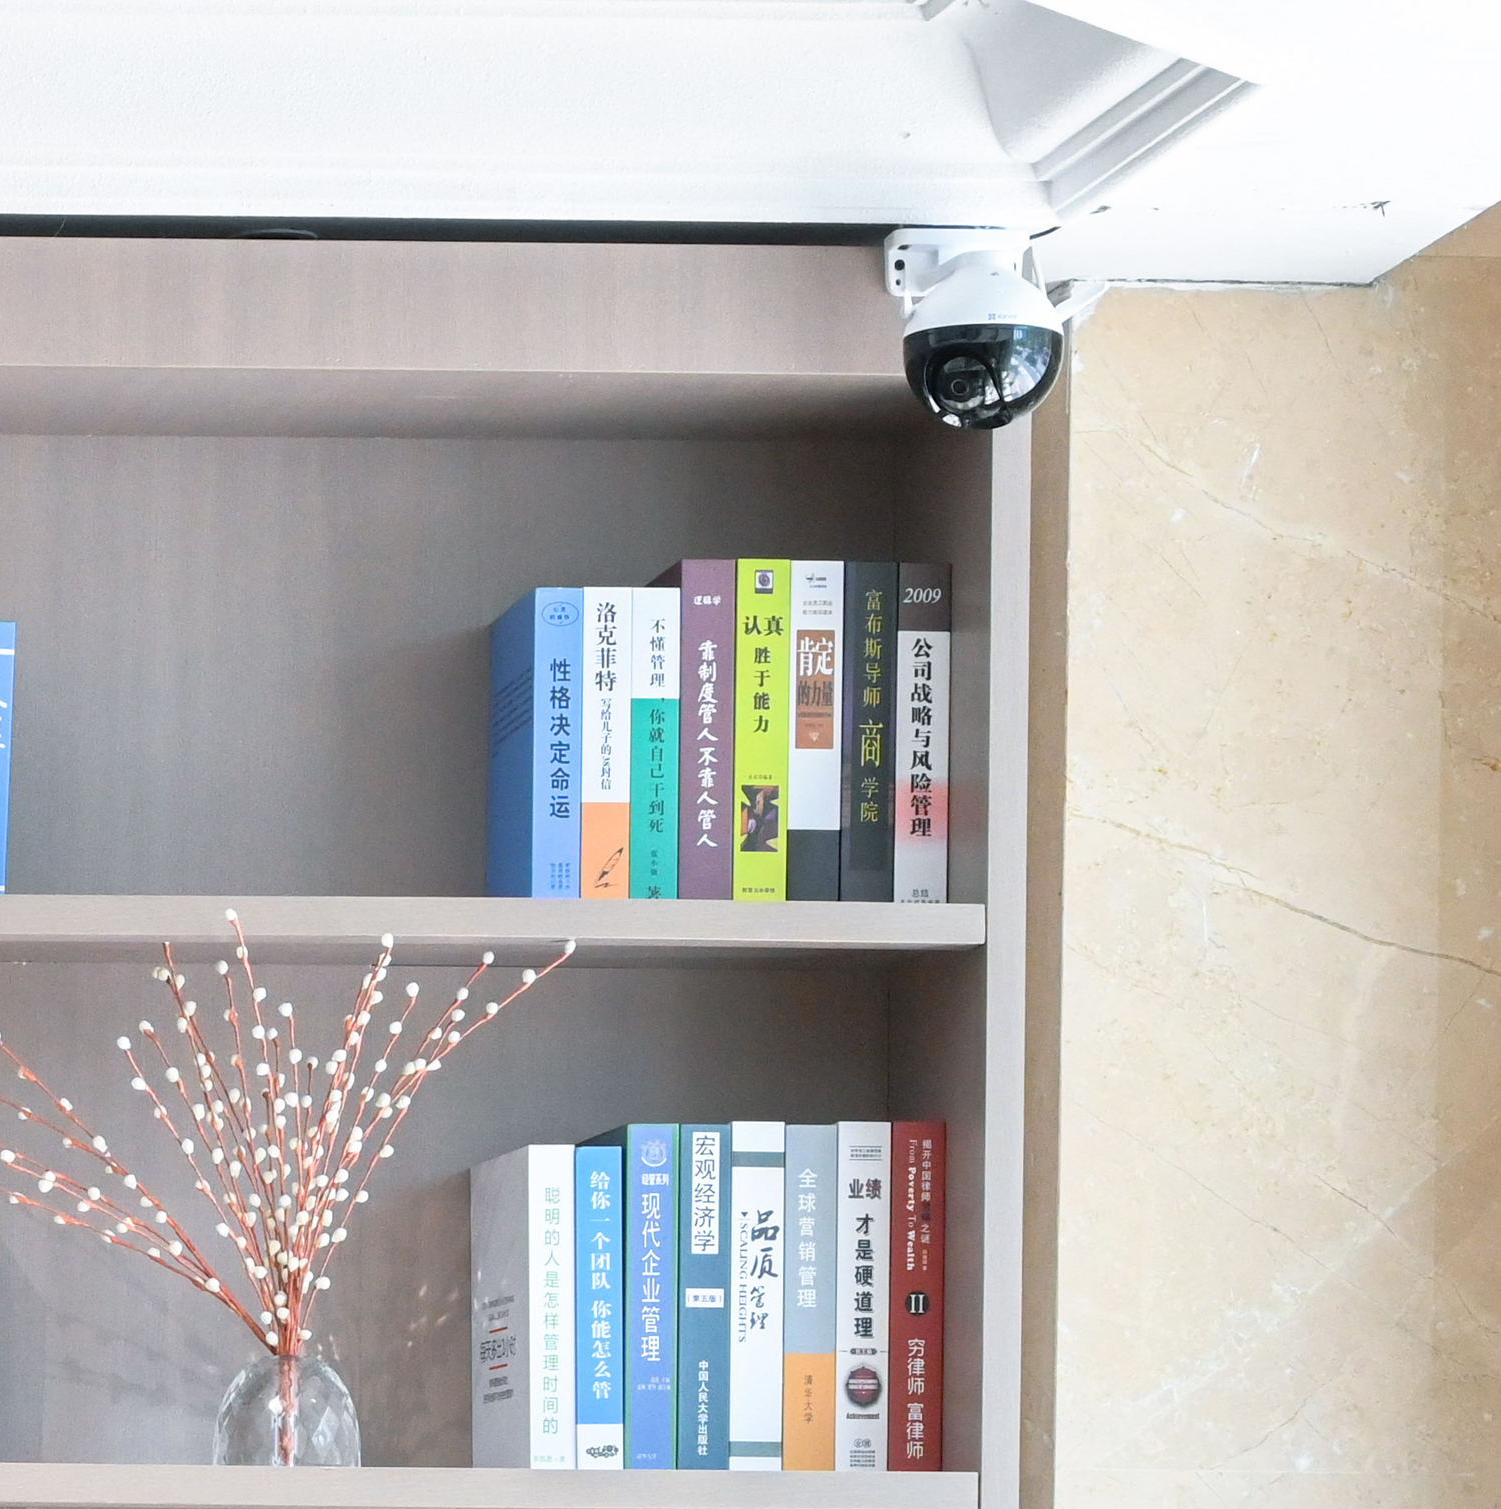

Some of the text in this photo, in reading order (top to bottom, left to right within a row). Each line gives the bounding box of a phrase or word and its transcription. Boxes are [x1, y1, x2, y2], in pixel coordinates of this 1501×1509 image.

[743, 616, 784, 636] 认真
[903, 588, 942, 604] 2009
[549, 658, 571, 819] 性格决定命运
[696, 640, 719, 848] 靠制度管人不靠人管人
[753, 646, 771, 734] 胜于能力
[910, 637, 933, 838] 公司战略与风险管理
[693, 1134, 717, 1252] 宏观经济学
[796, 1167, 819, 1308] 全球营销管理
[542, 1186, 561, 1435] 聪明的人是怎样管理时间的
[640, 1192, 661, 1363] 现代企业管理
[738, 1222, 749, 1343] SCALING HEIGHTS
[696, 1360, 709, 1456] 中国人民大学出版社
[803, 1374, 814, 1425] 清华大学
